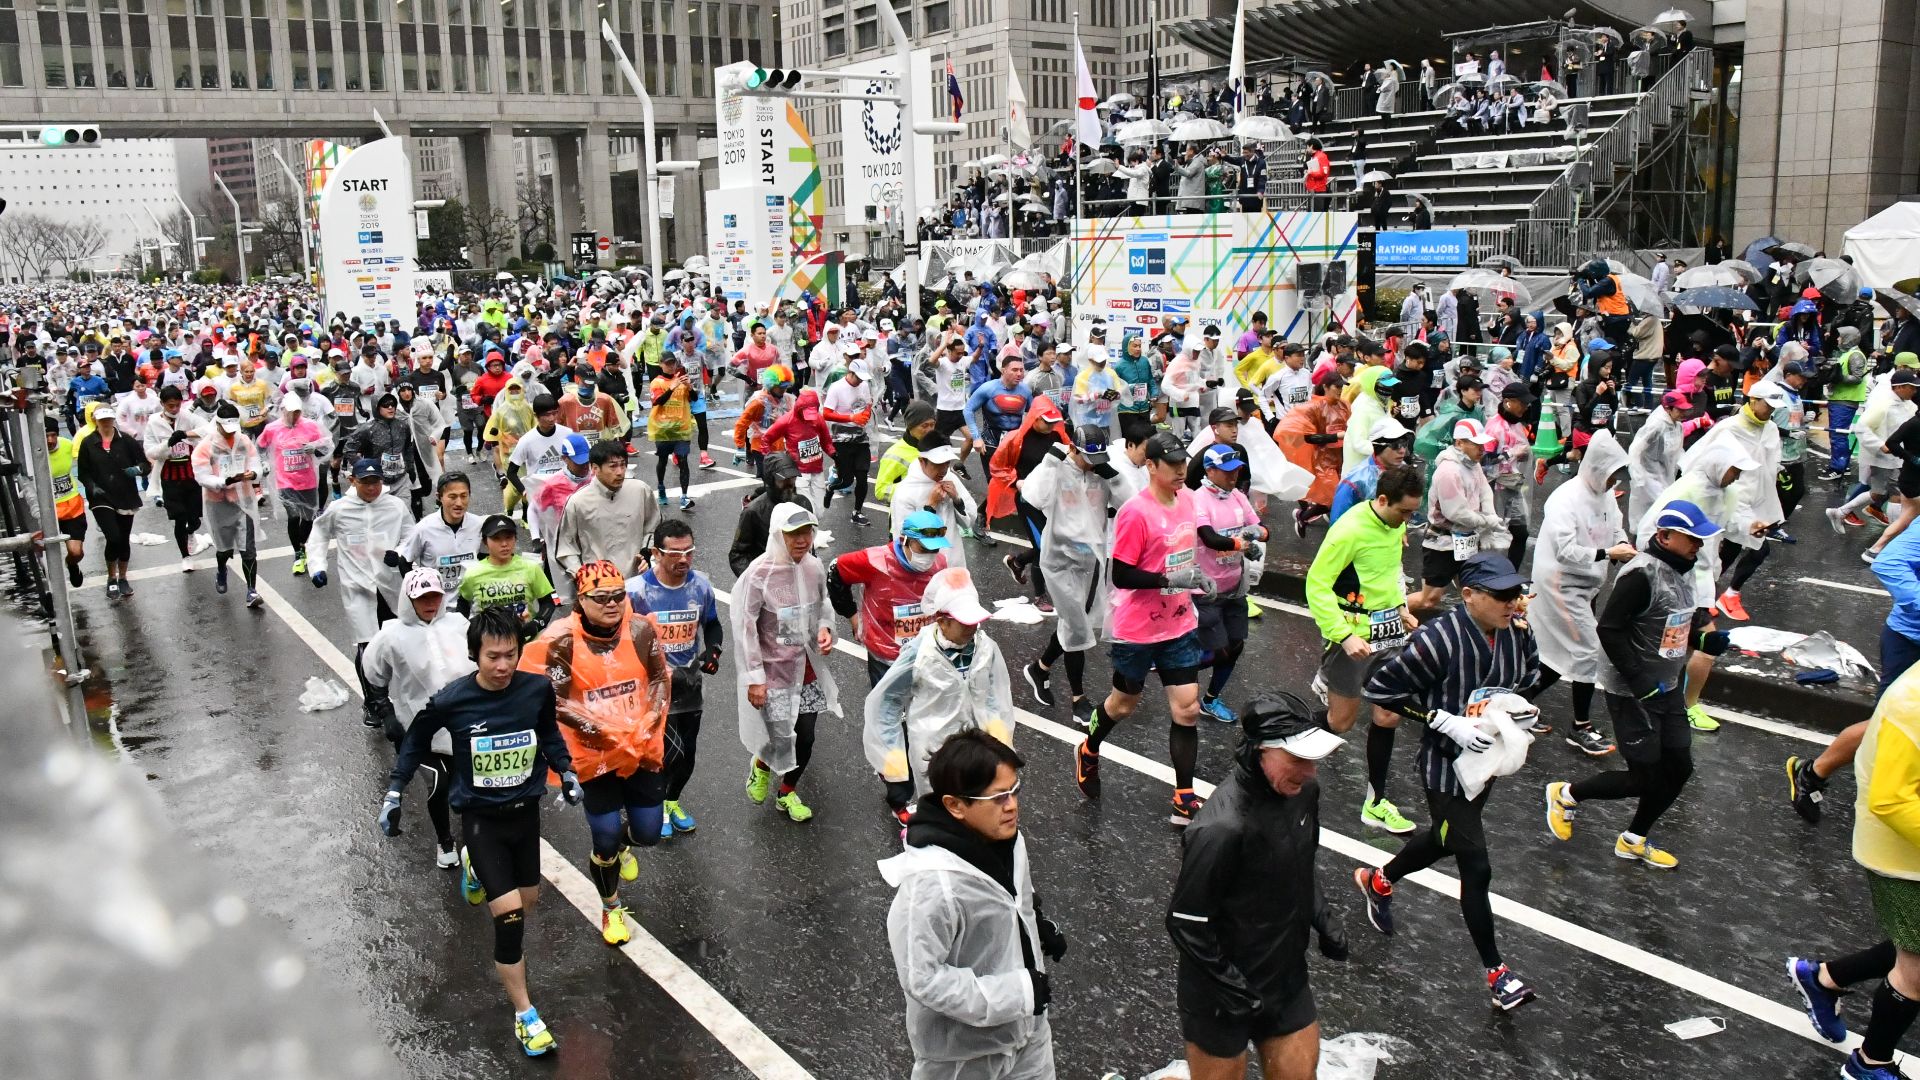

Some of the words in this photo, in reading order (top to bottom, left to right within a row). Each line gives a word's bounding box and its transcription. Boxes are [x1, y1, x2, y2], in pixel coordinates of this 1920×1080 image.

[724, 128, 745, 140] TOKYO
[724, 148, 746, 165] 2019
[760, 128, 775, 185] START
[861, 163, 890, 179] TOKYO
[342, 178, 389, 192] START
[360, 221, 380, 229] 2019
[1376, 245, 1417, 254] RATHON
[1420, 244, 1460, 254] MAJORS
[1198, 317, 1222, 326] SECOM
[479, 583, 526, 598] TOKYO
[494, 735, 529, 747] 東京メトロ
[472, 749, 529, 772] G28526
